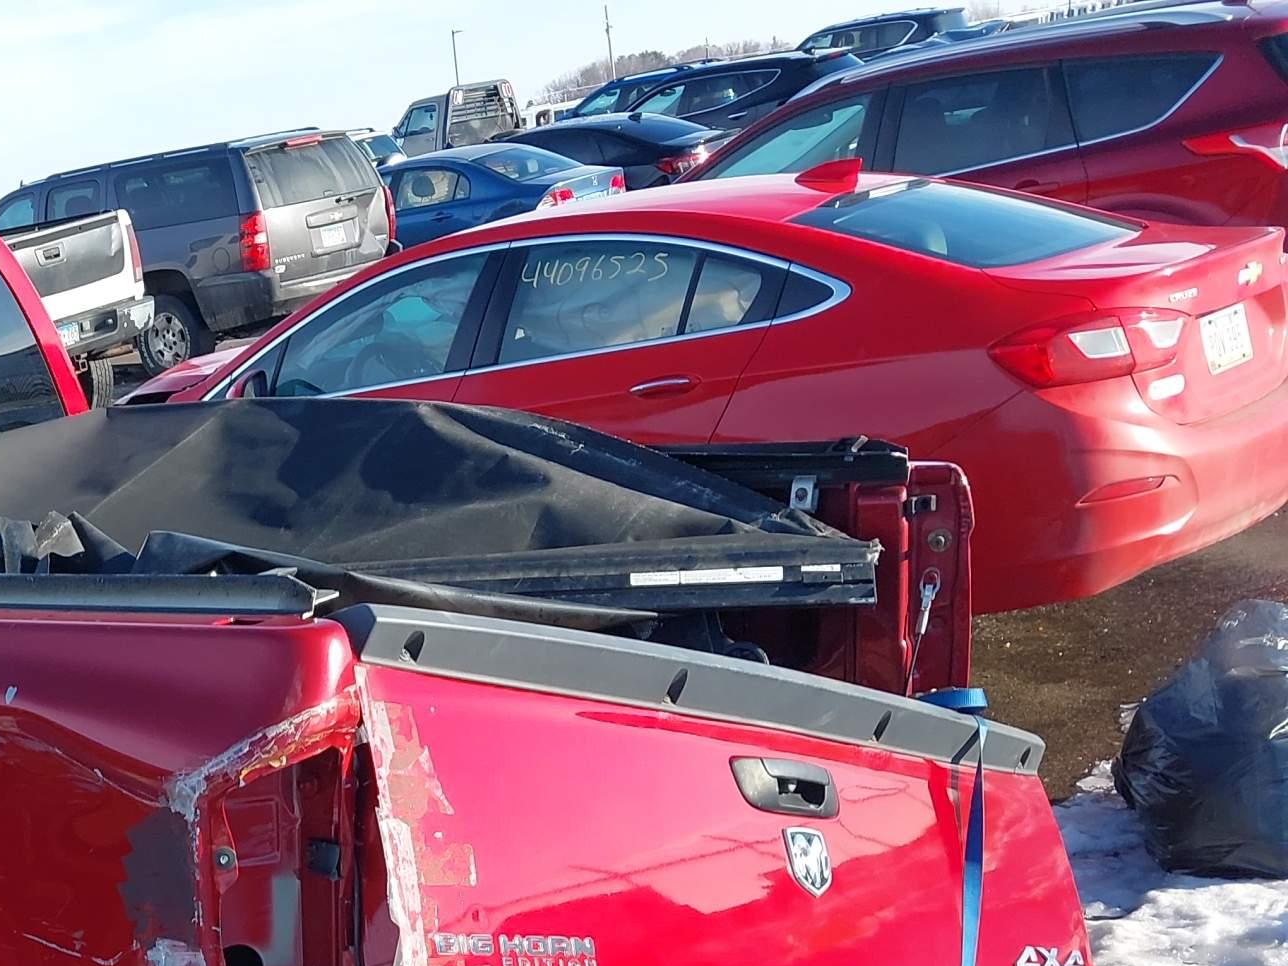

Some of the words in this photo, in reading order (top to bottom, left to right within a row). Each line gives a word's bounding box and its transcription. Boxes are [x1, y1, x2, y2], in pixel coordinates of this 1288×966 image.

[521, 252, 669, 288] 44096525
[435, 933, 494, 956] BIG
[499, 934, 596, 957] HORN
